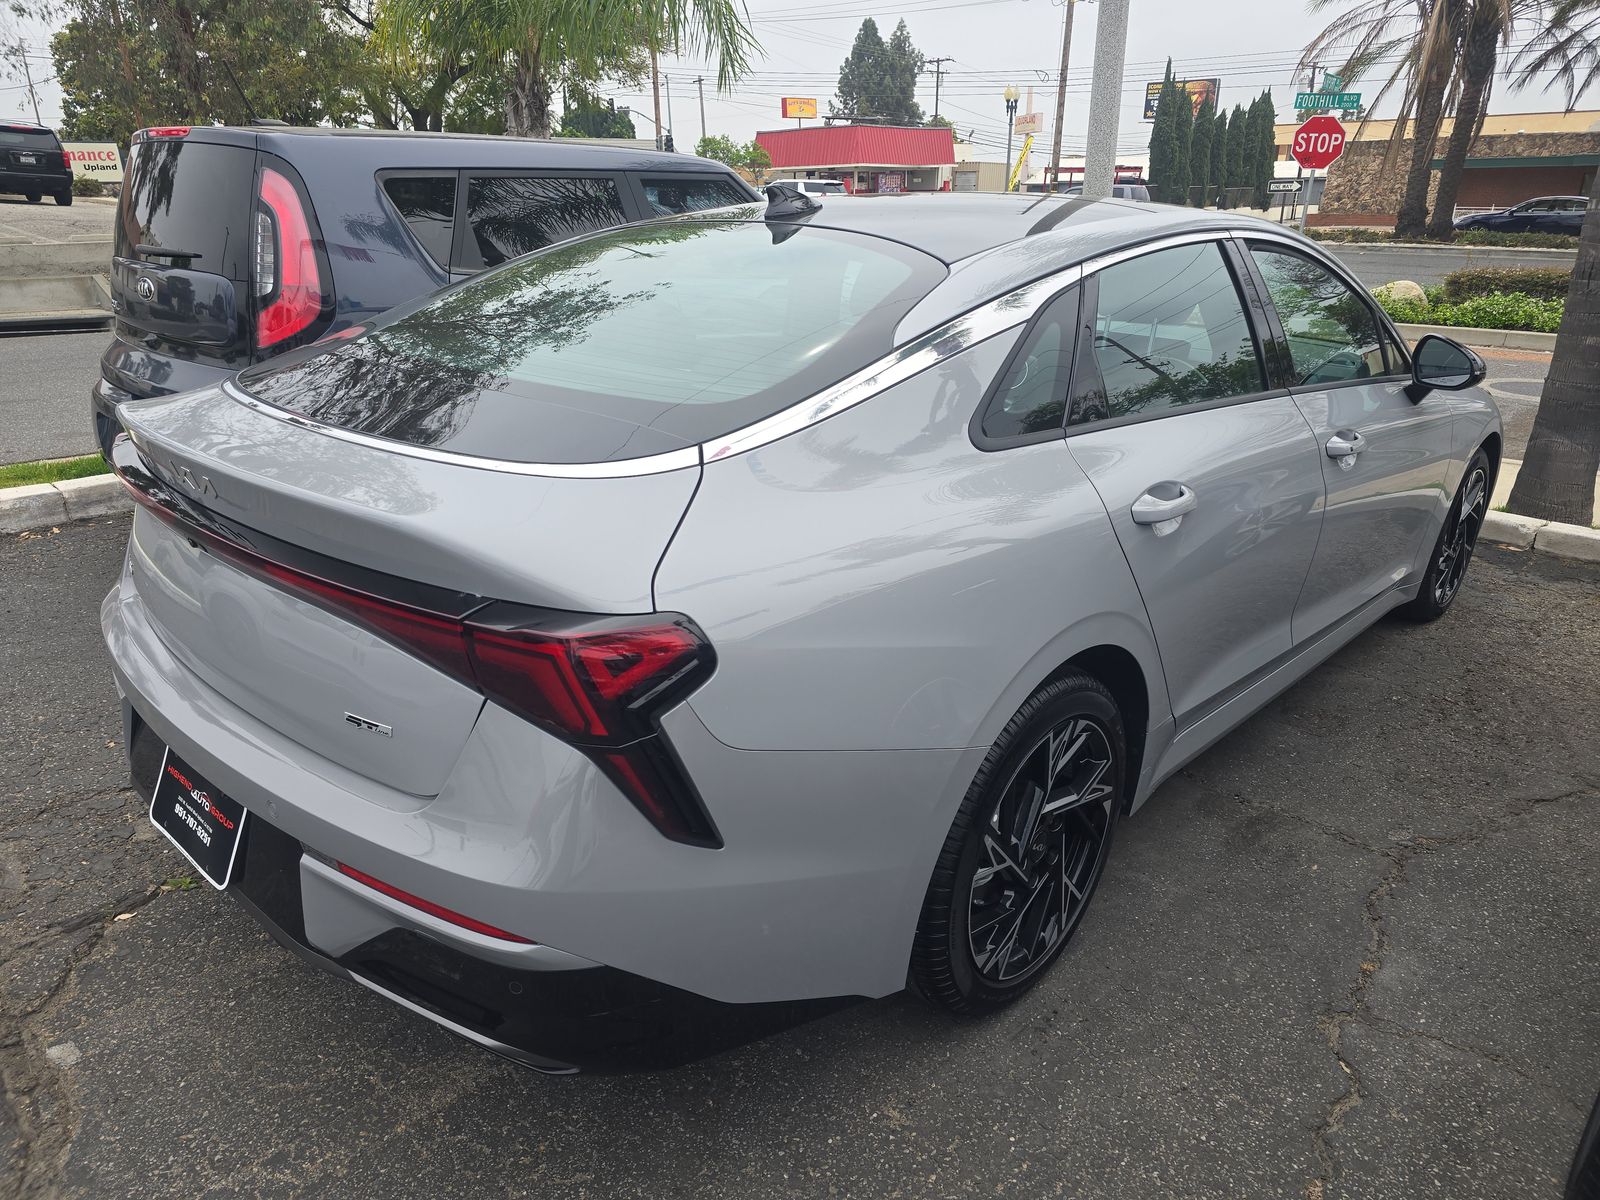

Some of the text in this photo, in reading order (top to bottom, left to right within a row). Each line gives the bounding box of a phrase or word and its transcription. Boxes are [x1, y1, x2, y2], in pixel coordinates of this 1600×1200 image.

[1296, 94, 1340, 108] FOOTHILL
[1295, 132, 1342, 153] STOP
[83, 163, 118, 172] Upland
[167, 765, 193, 791] HIGHEND
[191, 789, 210, 812] AUTO
[209, 806, 234, 830] GROUP
[174, 803, 212, 847] 951-707-5251
